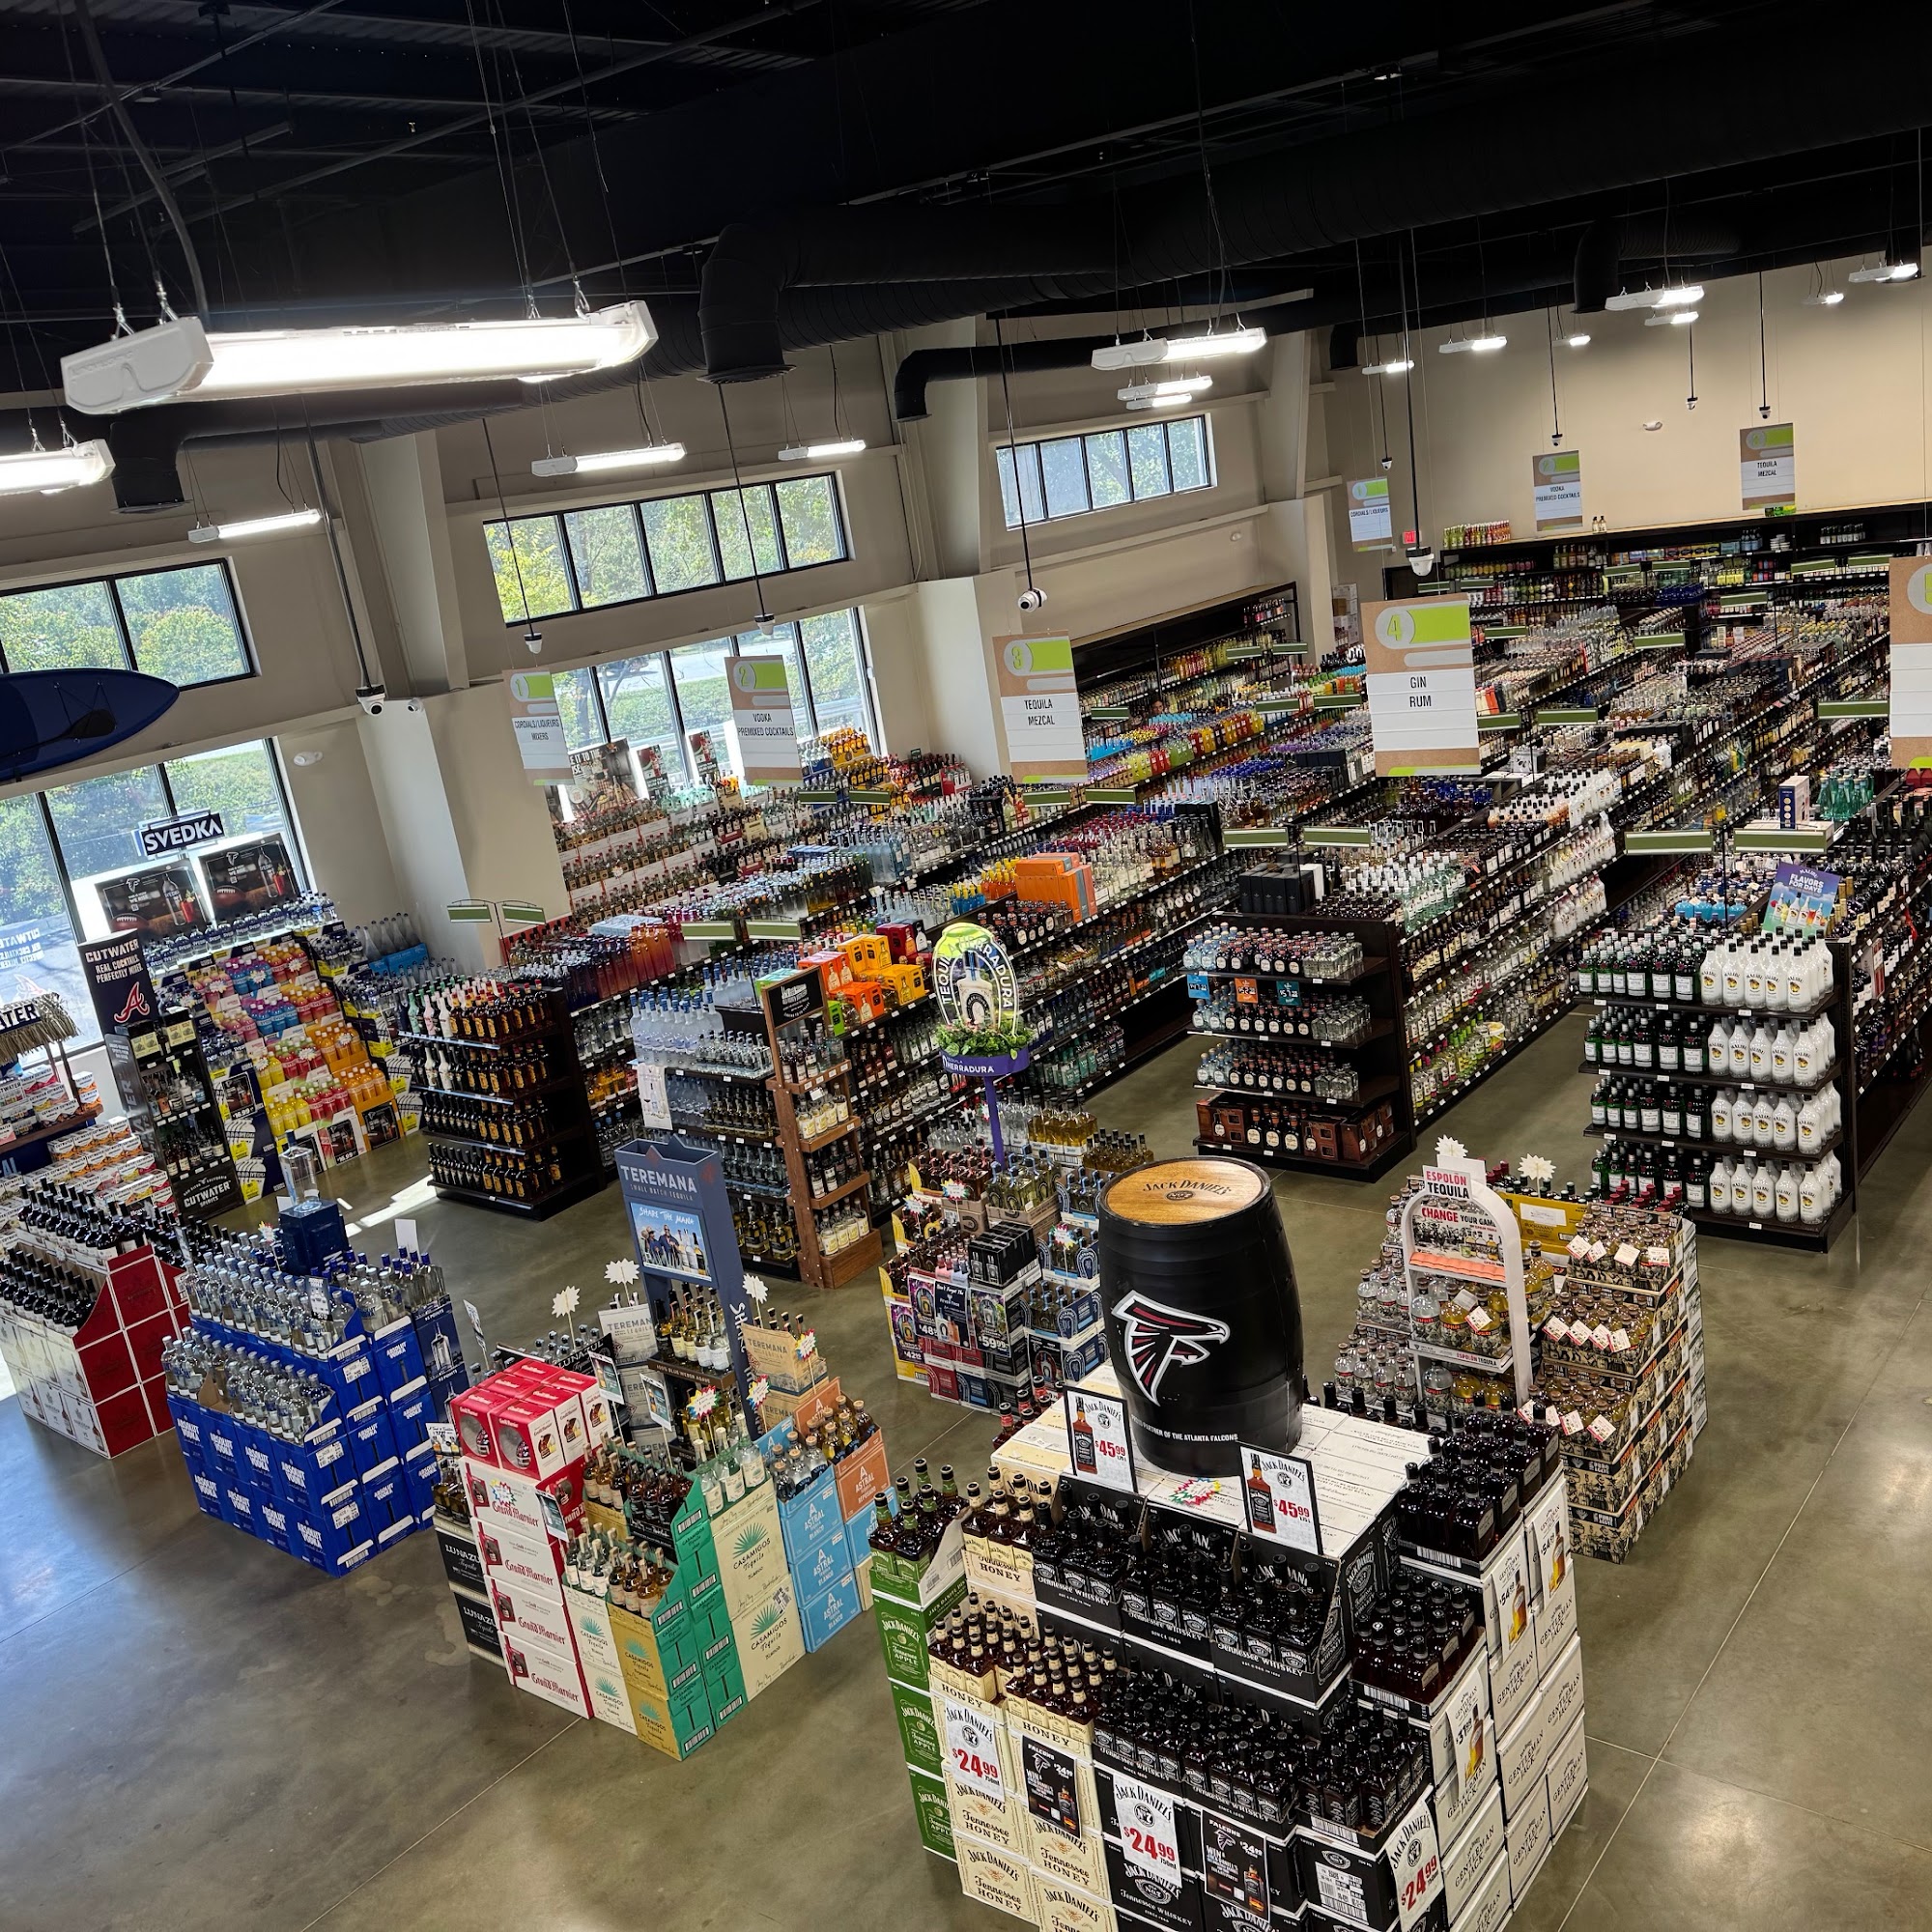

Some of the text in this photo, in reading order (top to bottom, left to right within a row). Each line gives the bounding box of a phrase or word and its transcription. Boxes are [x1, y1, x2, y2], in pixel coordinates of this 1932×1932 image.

[1387, 614, 1403, 641] 4
[1011, 646, 1023, 669] 3
[738, 666, 750, 687] 2
[1410, 676, 1426, 688] GIN
[1024, 699, 1053, 709] TEQUILA
[1409, 696, 1432, 707] RUM
[753, 713, 772, 723] VODKA
[1028, 715, 1055, 725] MEZCAL
[738, 727, 794, 737] PREMIXED COCKTAILS
[145, 819, 222, 852] SVEDKA
[1788, 880, 1823, 894] FOR DAYS
[1791, 873, 1825, 889] FLAVORS
[85, 939, 139, 963] CUTWATER
[96, 961, 111, 974] REAL
[96, 969, 128, 983] PERFECTLY
[947, 1060, 995, 1073] HERRADURA
[620, 1165, 697, 1193] TEREMANA
[1143, 1179, 1232, 1196] JACK DANIEL'S
[184, 1180, 232, 1208] CUTWATER
[1428, 1182, 1469, 1199] TEQUILA
[199, 1196, 218, 1208] SPIRITS
[639, 1208, 695, 1225] SHARE THE MANA
[1421, 1207, 1459, 1222] CHANGE
[1461, 1215, 1478, 1225] YOUR
[607, 1317, 653, 1330] TEREMAN
[748, 1338, 787, 1353] TEREMANA
[1478, 1356, 1497, 1367] TEQUILA
[1085, 1401, 1122, 1422] JACK DANIEL'S
[1172, 1432, 1183, 1440] THE
[855, 1472, 875, 1493] ASTRAL
[1262, 1460, 1305, 1483] JACK DANIEL'S
[512, 1508, 539, 1527] Marnier
[805, 1509, 825, 1531] ASTRAL
[444, 1544, 482, 1563] LUNAZU
[733, 1538, 771, 1570] CASAMIGOS
[743, 1552, 764, 1572] Tequila
[526, 1565, 554, 1586] Marnier
[813, 1555, 835, 1577] ASTRAL
[980, 1562, 1021, 1582] HONEY
[1037, 1577, 1073, 1594] Tennessee
[1075, 1588, 1110, 1606] WHISKEY
[823, 1599, 844, 1621] ASTRAL
[1540, 1595, 1573, 1645] GENTLEMAN
[751, 1617, 788, 1651] CASAMIGOS
[882, 1620, 920, 1641] JACK DANIEL'S
[1166, 1624, 1202, 1641] WHISKEY
[1551, 1619, 1565, 1641] JACK
[760, 1632, 781, 1652] Tequila
[625, 1652, 653, 1668] CASAMIGOS
[895, 1654, 919, 1665] APPLE
[1217, 1643, 1260, 1662] Tennessee
[1262, 1658, 1303, 1677] WHISKEY
[1496, 1651, 1534, 1705] GENTLEMAN
[1509, 1676, 1525, 1702] JACK
[942, 1684, 983, 1709] HONEY
[1548, 1673, 1581, 1723] GENTLEMAN
[901, 1706, 935, 1728] JACK DANIEL
[1558, 1697, 1572, 1721] JACK
[639, 1714, 666, 1731] CASAMIGOS
[946, 1707, 993, 1743] JACK DANIEL'S
[1023, 1721, 1069, 1747] HONEY
[1028, 1744, 1055, 1760] FALCONS
[1508, 1729, 1544, 1785] GENTLEMAN
[1520, 1755, 1536, 1780] JACK
[1553, 1748, 1583, 1802] GENTLEMAN
[918, 1792, 932, 1804] JACK
[1563, 1774, 1577, 1800] JACK
[1115, 1784, 1173, 1821] JACK DANIEL'S
[962, 1809, 1009, 1837] Tennessee
[965, 1822, 1009, 1845] HONEY
[1208, 1819, 1241, 1837] FALCONS
[1391, 1809, 1431, 1869] JACK DANIEL'S
[1513, 1806, 1548, 1865] GENTLEMAN
[1455, 1825, 1494, 1888] GENTLEMAN
[1523, 1833, 1539, 1861] JACK
[969, 1849, 1020, 1882] JACK DANIEL'S
[1040, 1847, 1090, 1878] Tennessee
[1044, 1860, 1090, 1887] HONEY
[1123, 1862, 1146, 1878] JACK
[1467, 1855, 1485, 1883] JACK
[975, 1875, 1022, 1904] Tennessee
[978, 1888, 1022, 1912] HONEY
[1044, 1888, 1100, 1922] JACK DANIEL'S
[1120, 1889, 1193, 1926] Tennessee WHISKEY
[1220, 1903, 1243, 1919] JACK
